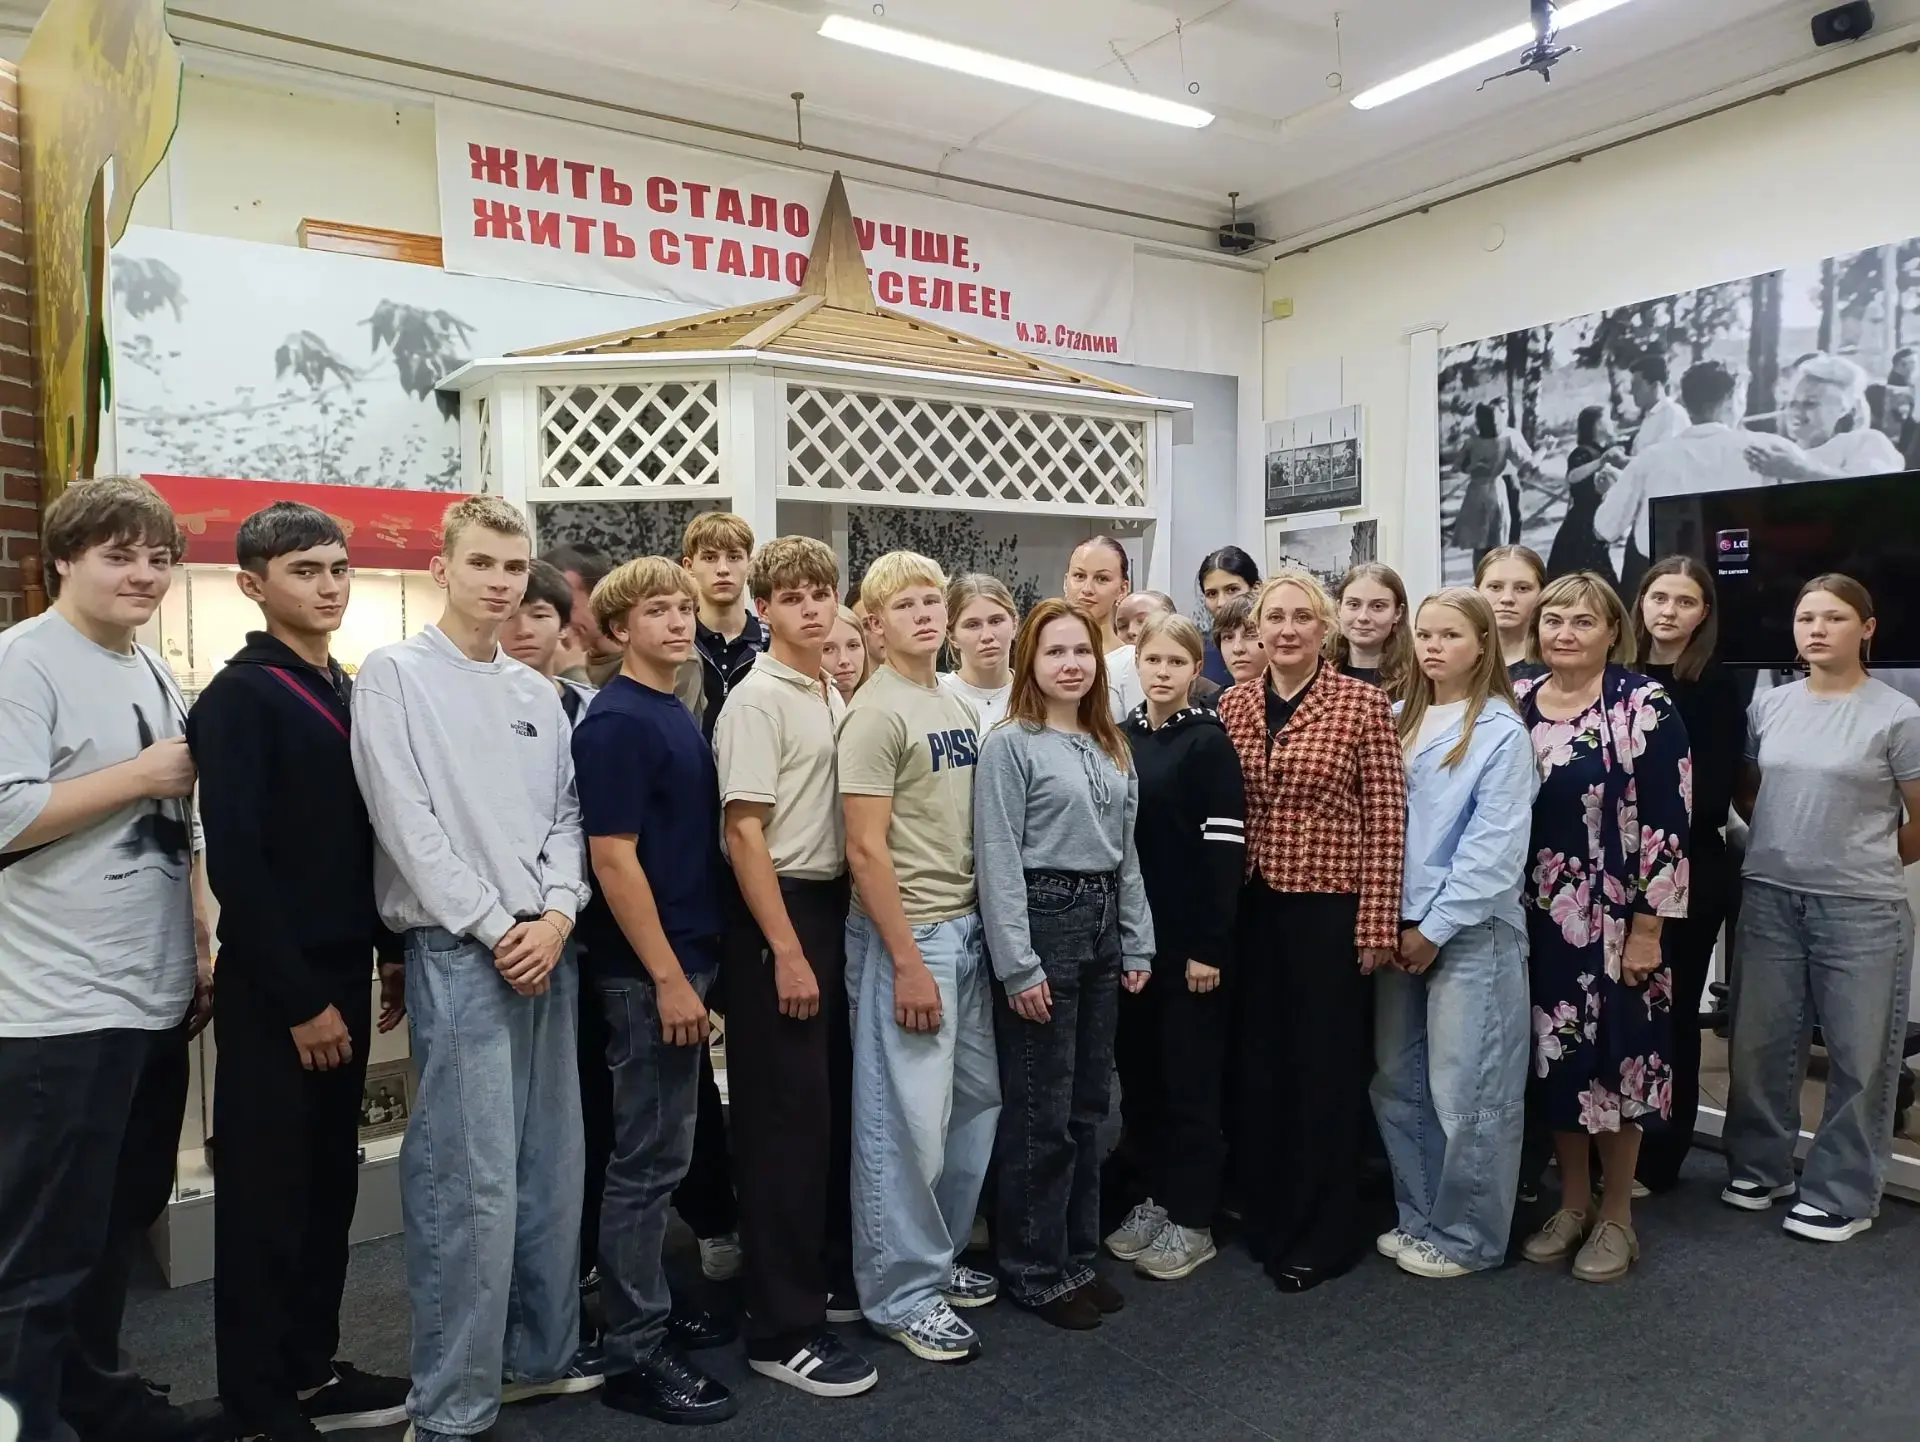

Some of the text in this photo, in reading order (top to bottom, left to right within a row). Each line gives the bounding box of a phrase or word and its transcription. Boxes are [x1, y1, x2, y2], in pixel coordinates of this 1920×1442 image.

[467, 142, 980, 273] ЖИТЬ СТАЛО УЧШЕ,
[472, 198, 1011, 321] ЖИТЬ СТАЛО СЕЛЕЕ!
[1055, 324, 1118, 354] Сталин
[1733, 540, 1749, 549] LG
